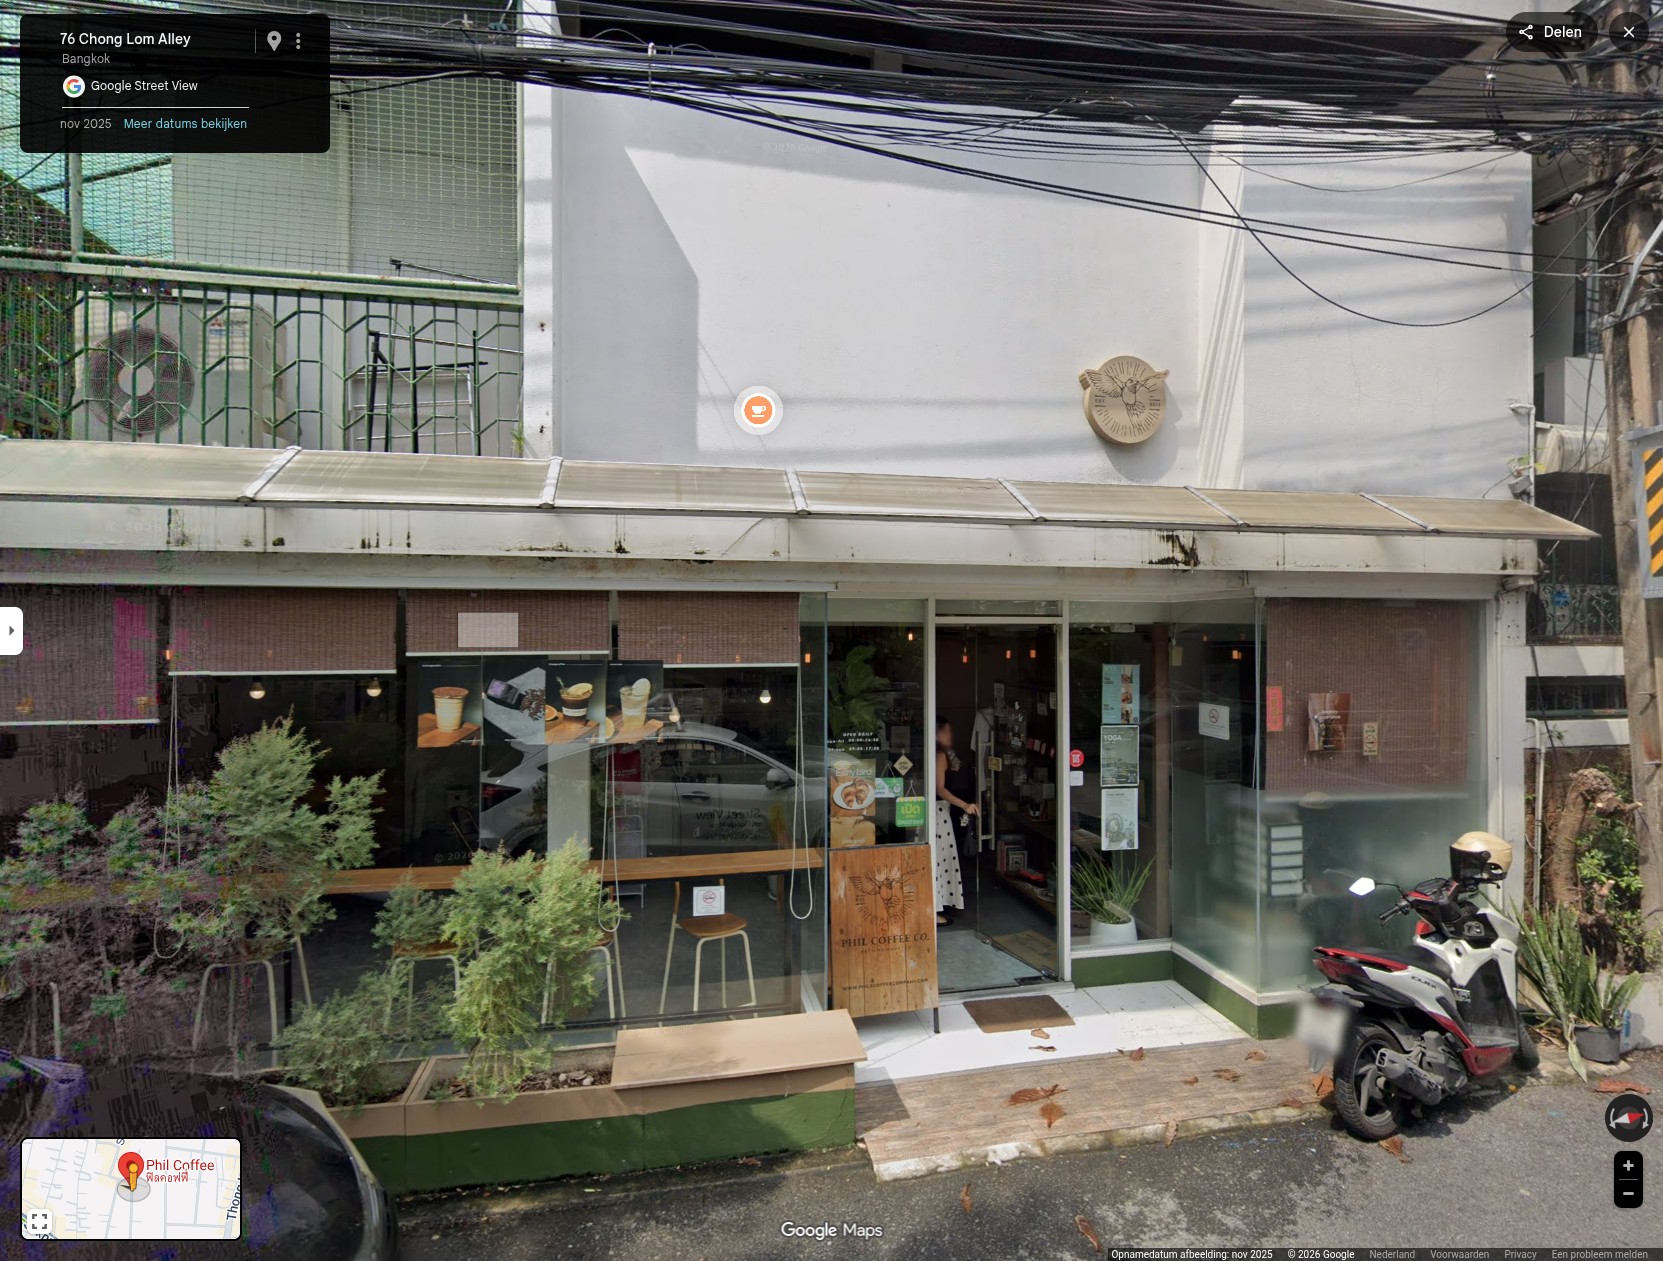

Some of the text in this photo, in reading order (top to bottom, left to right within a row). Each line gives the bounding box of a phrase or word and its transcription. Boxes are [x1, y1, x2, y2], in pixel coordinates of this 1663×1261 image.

[835, 769, 856, 778] Early
[841, 937, 868, 948] PHIL
[871, 933, 911, 945] COFFEE
[913, 932, 930, 942] CO.
